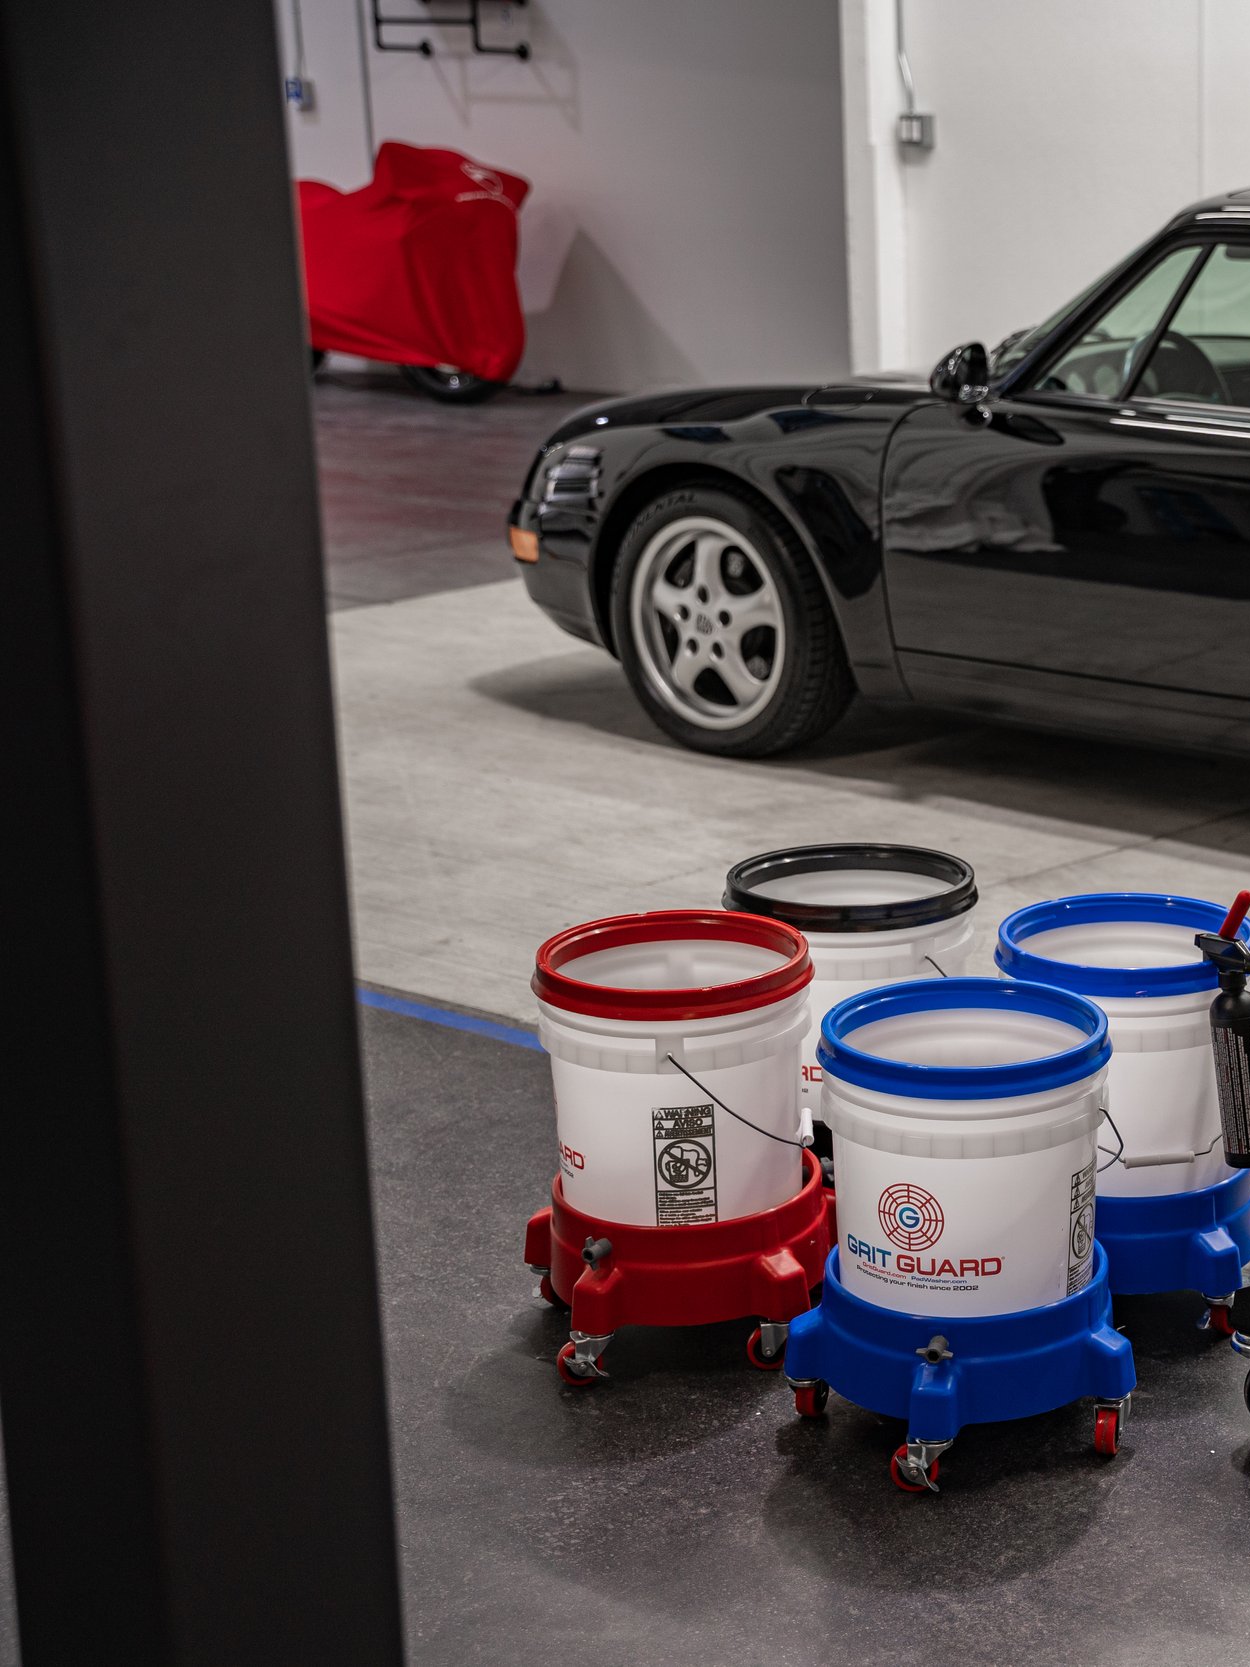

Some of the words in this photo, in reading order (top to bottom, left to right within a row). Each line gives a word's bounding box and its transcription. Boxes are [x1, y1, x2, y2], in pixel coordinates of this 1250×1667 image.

[899, 1207, 920, 1228] G
[848, 1233, 891, 1268] GRIT
[896, 1254, 1002, 1277] GUARD
[856, 1264, 889, 1284] Protecting
[889, 1278, 906, 1286] your
[906, 1281, 928, 1290] finish
